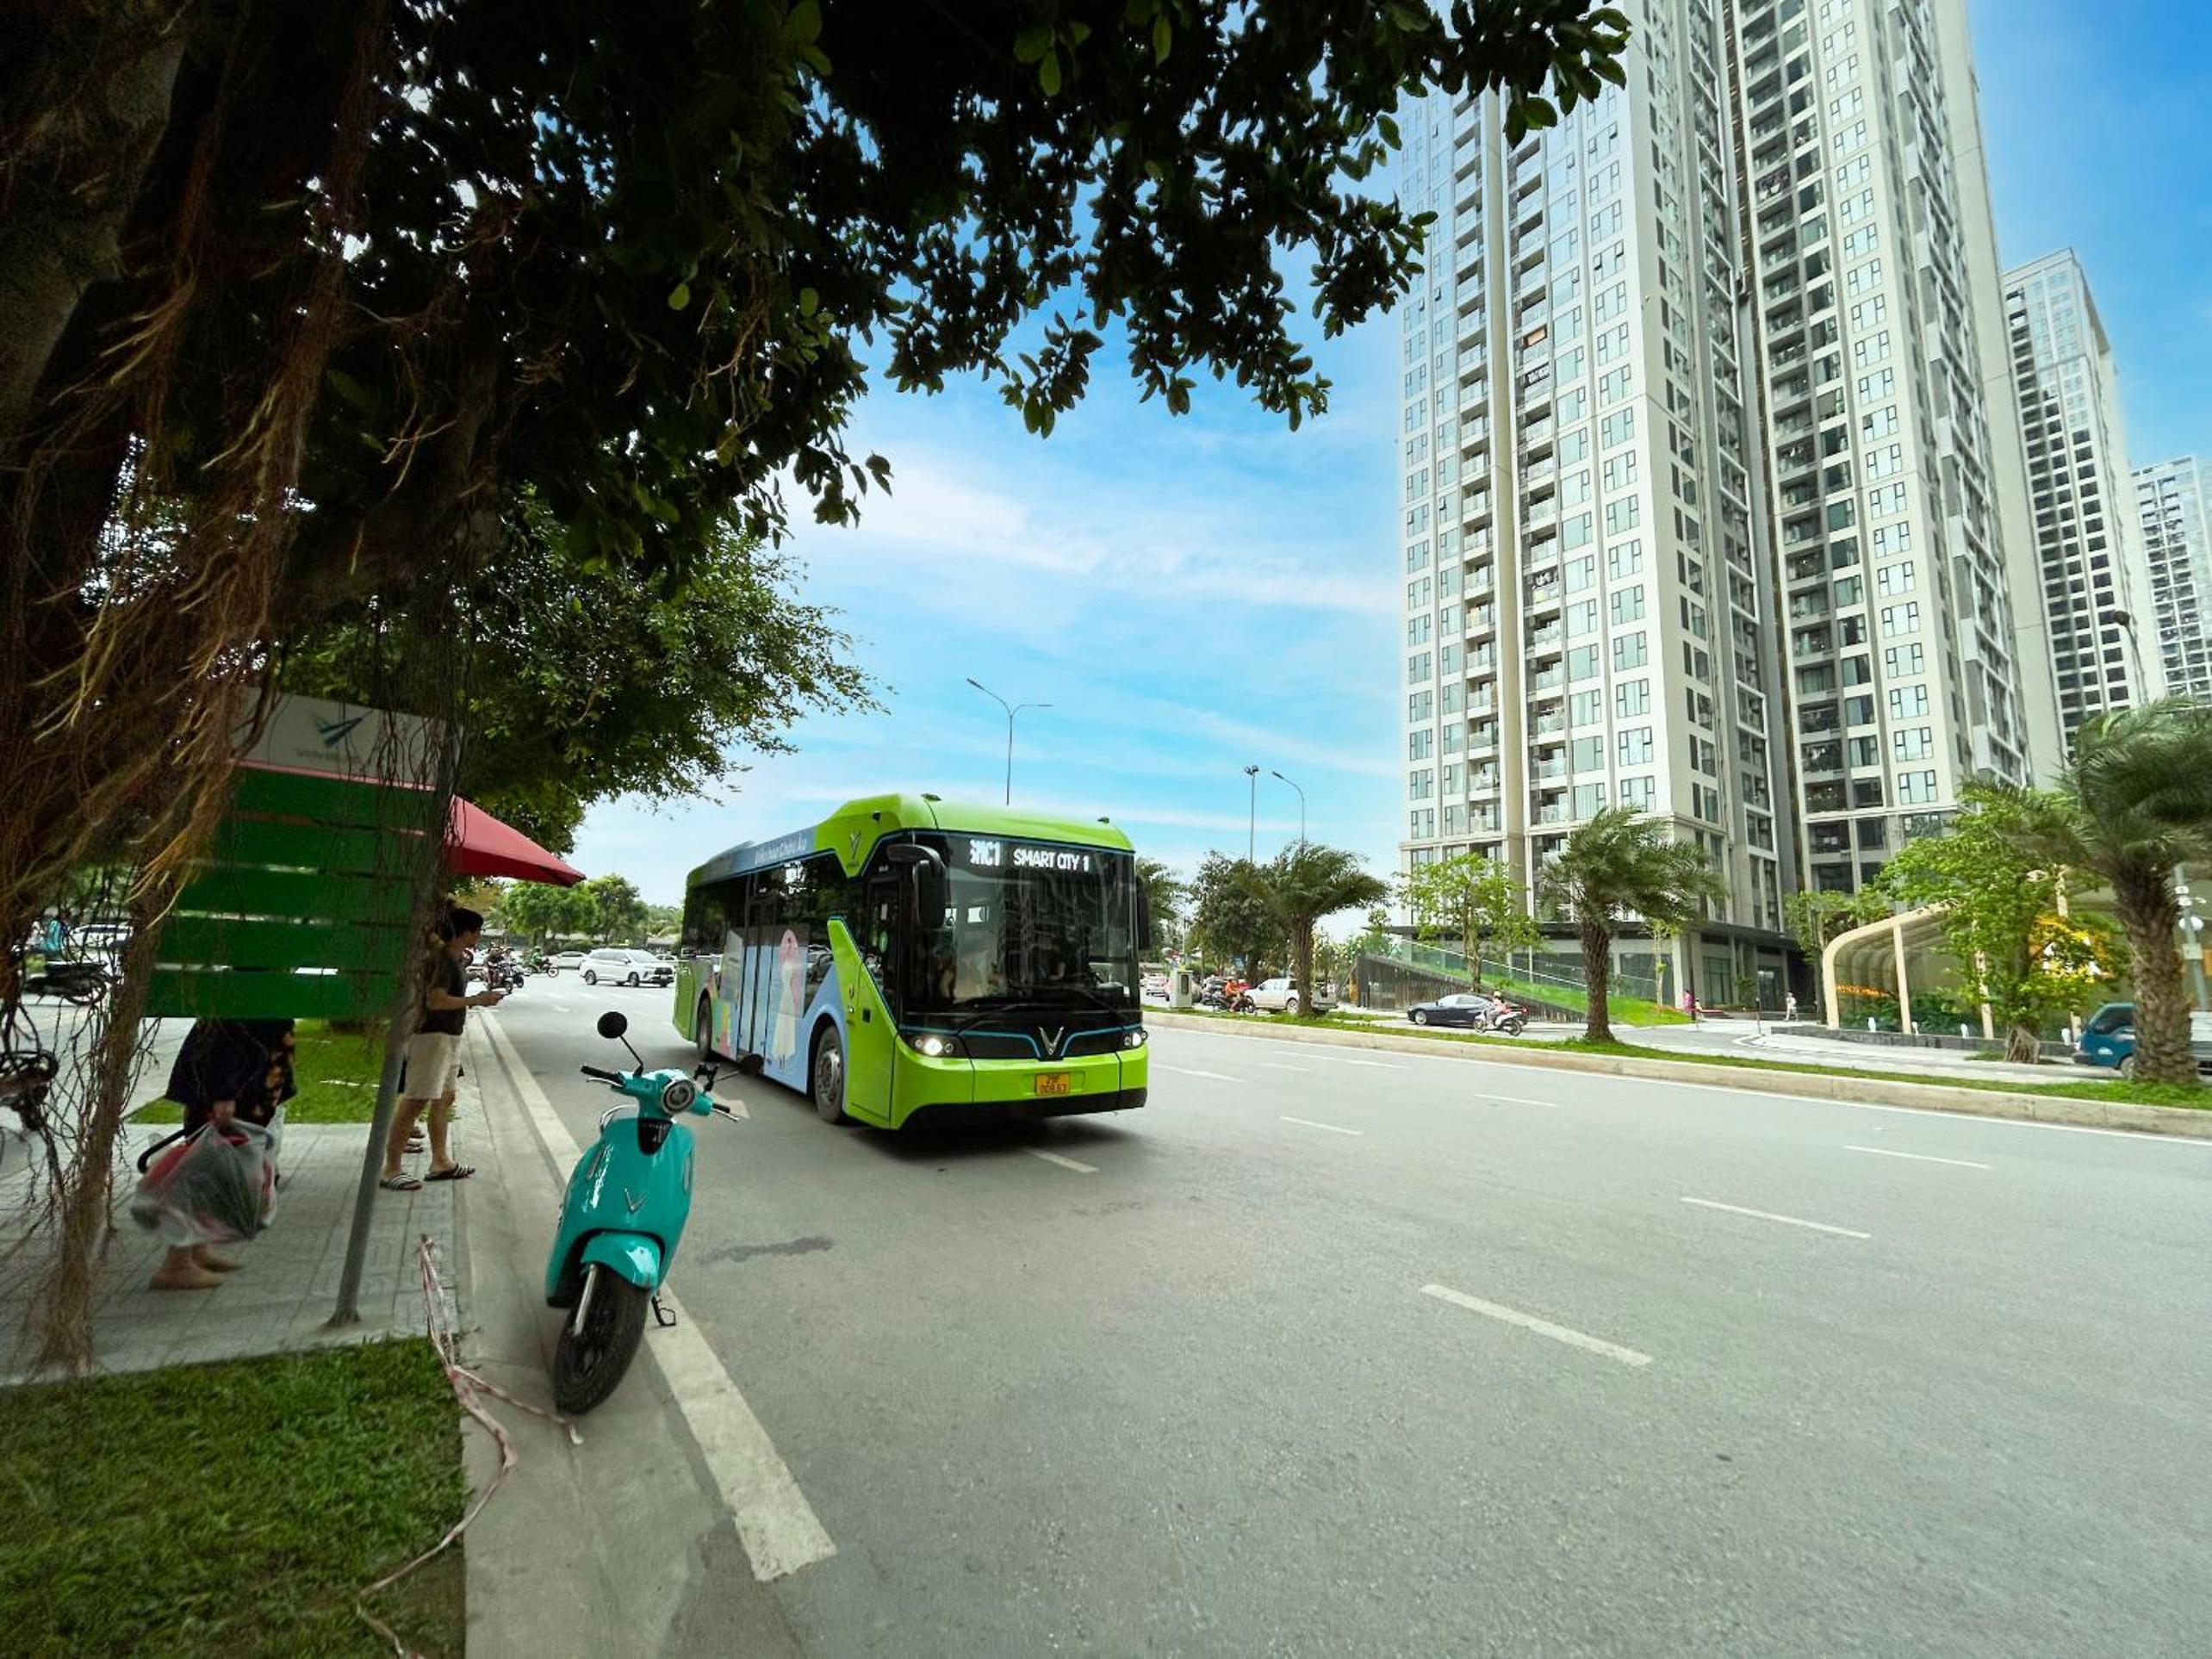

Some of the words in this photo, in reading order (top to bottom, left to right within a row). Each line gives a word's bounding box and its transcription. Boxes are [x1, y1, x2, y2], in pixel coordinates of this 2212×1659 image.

[1013, 848, 1055, 868] SMART
[1057, 853, 1079, 871] CITY
[1083, 855, 1090, 872] 1
